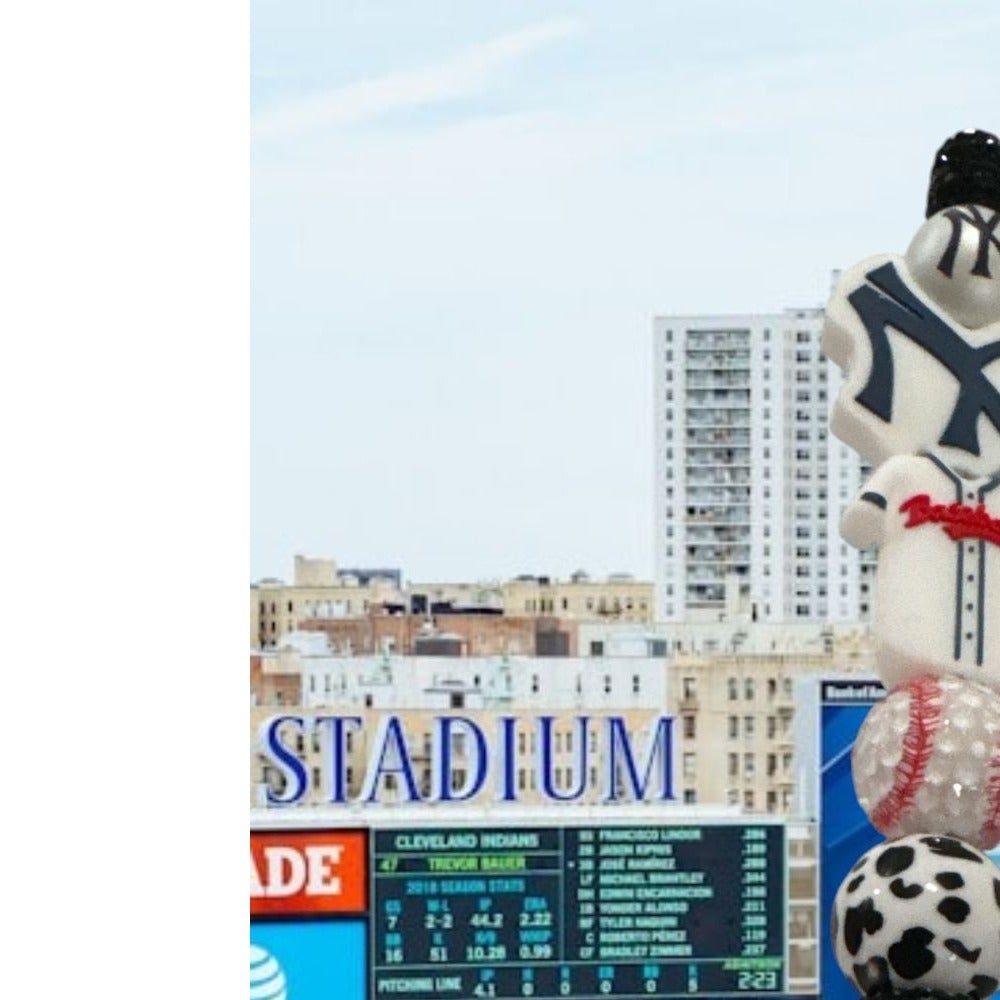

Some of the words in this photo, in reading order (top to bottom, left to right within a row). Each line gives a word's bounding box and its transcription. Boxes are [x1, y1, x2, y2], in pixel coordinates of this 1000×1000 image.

[262, 714, 678, 804] STADIUM
[395, 834, 478, 848] CLEVELAND
[480, 832, 540, 847] INDIANS
